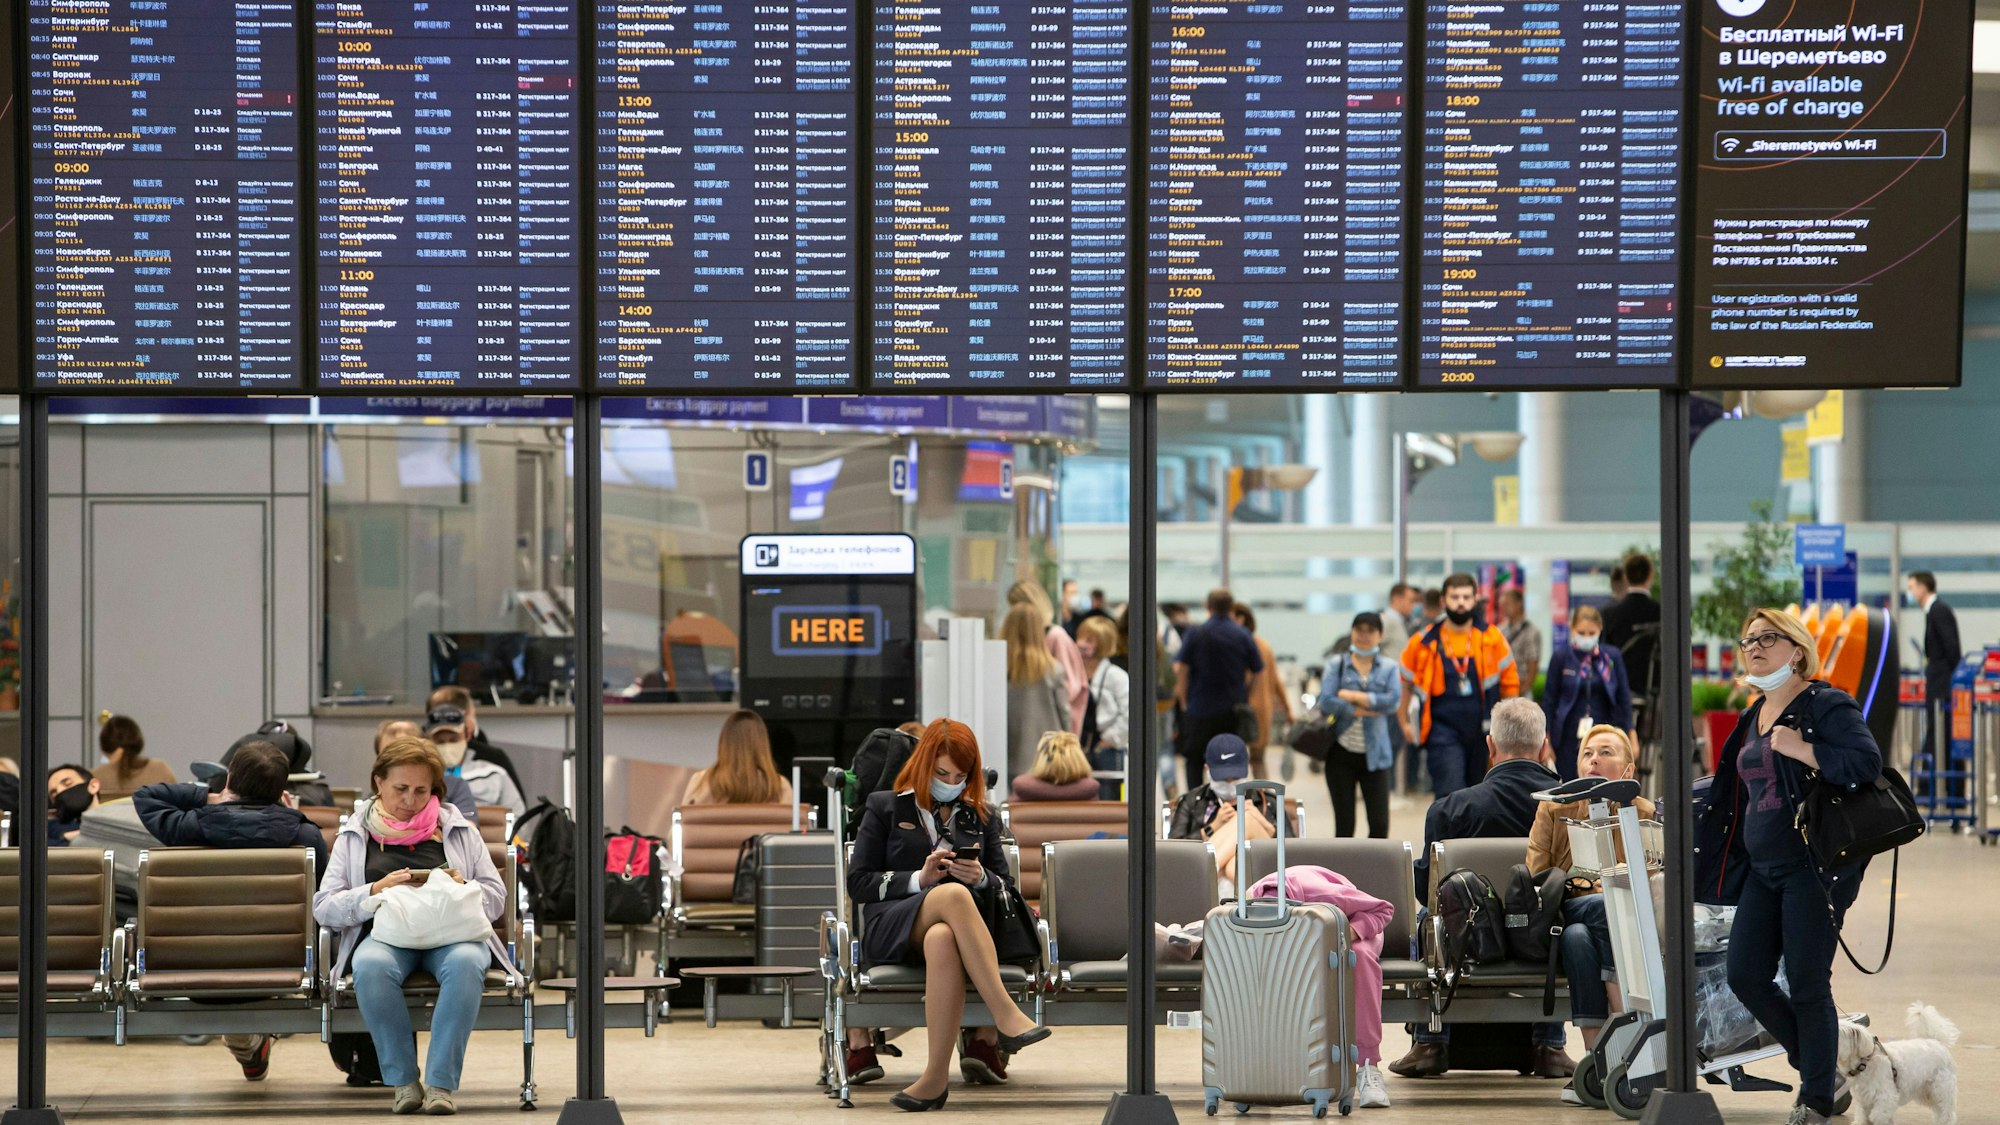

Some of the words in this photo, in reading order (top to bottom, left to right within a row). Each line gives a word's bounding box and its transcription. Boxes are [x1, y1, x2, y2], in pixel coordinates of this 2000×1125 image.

[1173, 27, 1204, 37] 16:00
[1720, 25, 1846, 43] Бесплатный
[1852, 24, 1903, 41] Wi-Fi
[339, 42, 371, 52] 10:00
[1171, 41, 1187, 49] Уфа
[52, 53, 99, 61] Сыктывкар
[338, 56, 381, 65] Волгоград
[1719, 52, 1732, 65] в
[1737, 49, 1886, 68] Шереметьево
[1718, 76, 1765, 93] Wi-fi
[1771, 76, 1862, 93] available
[619, 96, 652, 106] 13:00
[1447, 96, 1479, 106] 18:00
[1718, 99, 1759, 115] free
[1765, 99, 1788, 115] of
[1793, 99, 1864, 118] charge
[367, 127, 401, 136] Уренгой
[896, 132, 928, 142] 15:00
[54, 142, 125, 151] Санкт-Петербург
[1844, 139, 1876, 150] Wi-Fi
[54, 163, 89, 173] 09:00
[55, 177, 102, 185] Геленджик
[1714, 219, 1748, 229] Нужна
[1749, 220, 1814, 229] регистрация
[1830, 220, 1869, 228] номеру
[1714, 232, 1763, 241] телефона
[1795, 231, 1855, 241] требование
[1713, 244, 1790, 253] Постановления
[1792, 244, 1867, 254] Правительства
[1713, 257, 1729, 265] РФ
[1730, 257, 1761, 265] №785
[1762, 257, 1775, 265] от
[1777, 257, 1830, 265] 12.08.2014
[341, 271, 374, 280] 11:00
[1444, 270, 1476, 279] 19:00
[1170, 288, 1202, 297] 17:00
[1712, 295, 1736, 303] User
[1737, 294, 1797, 305] registration
[1799, 294, 1821, 302] with
[1833, 294, 1857, 302] valid
[620, 306, 652, 315] 14:00
[1712, 308, 1745, 318] phone
[1747, 308, 1787, 316] number
[1789, 307, 1798, 316] is
[1800, 307, 1844, 317] required
[1846, 307, 1859, 317] by
[340, 320, 397, 328] Екатеринбург
[894, 320, 933, 328] Оренбург
[1168, 319, 1193, 327] Прага
[1711, 322, 1728, 330] the
[1730, 322, 1748, 330] law
[1749, 321, 1761, 330] of
[1762, 322, 1779, 330] the
[1781, 321, 1819, 330] Russian
[1820, 320, 1873, 329] Federation
[57, 353, 74, 361] Уфа
[1167, 370, 1235, 380] Санкт-Петербург
[1442, 372, 1474, 382] 20:00
[791, 618, 864, 642] HERE
